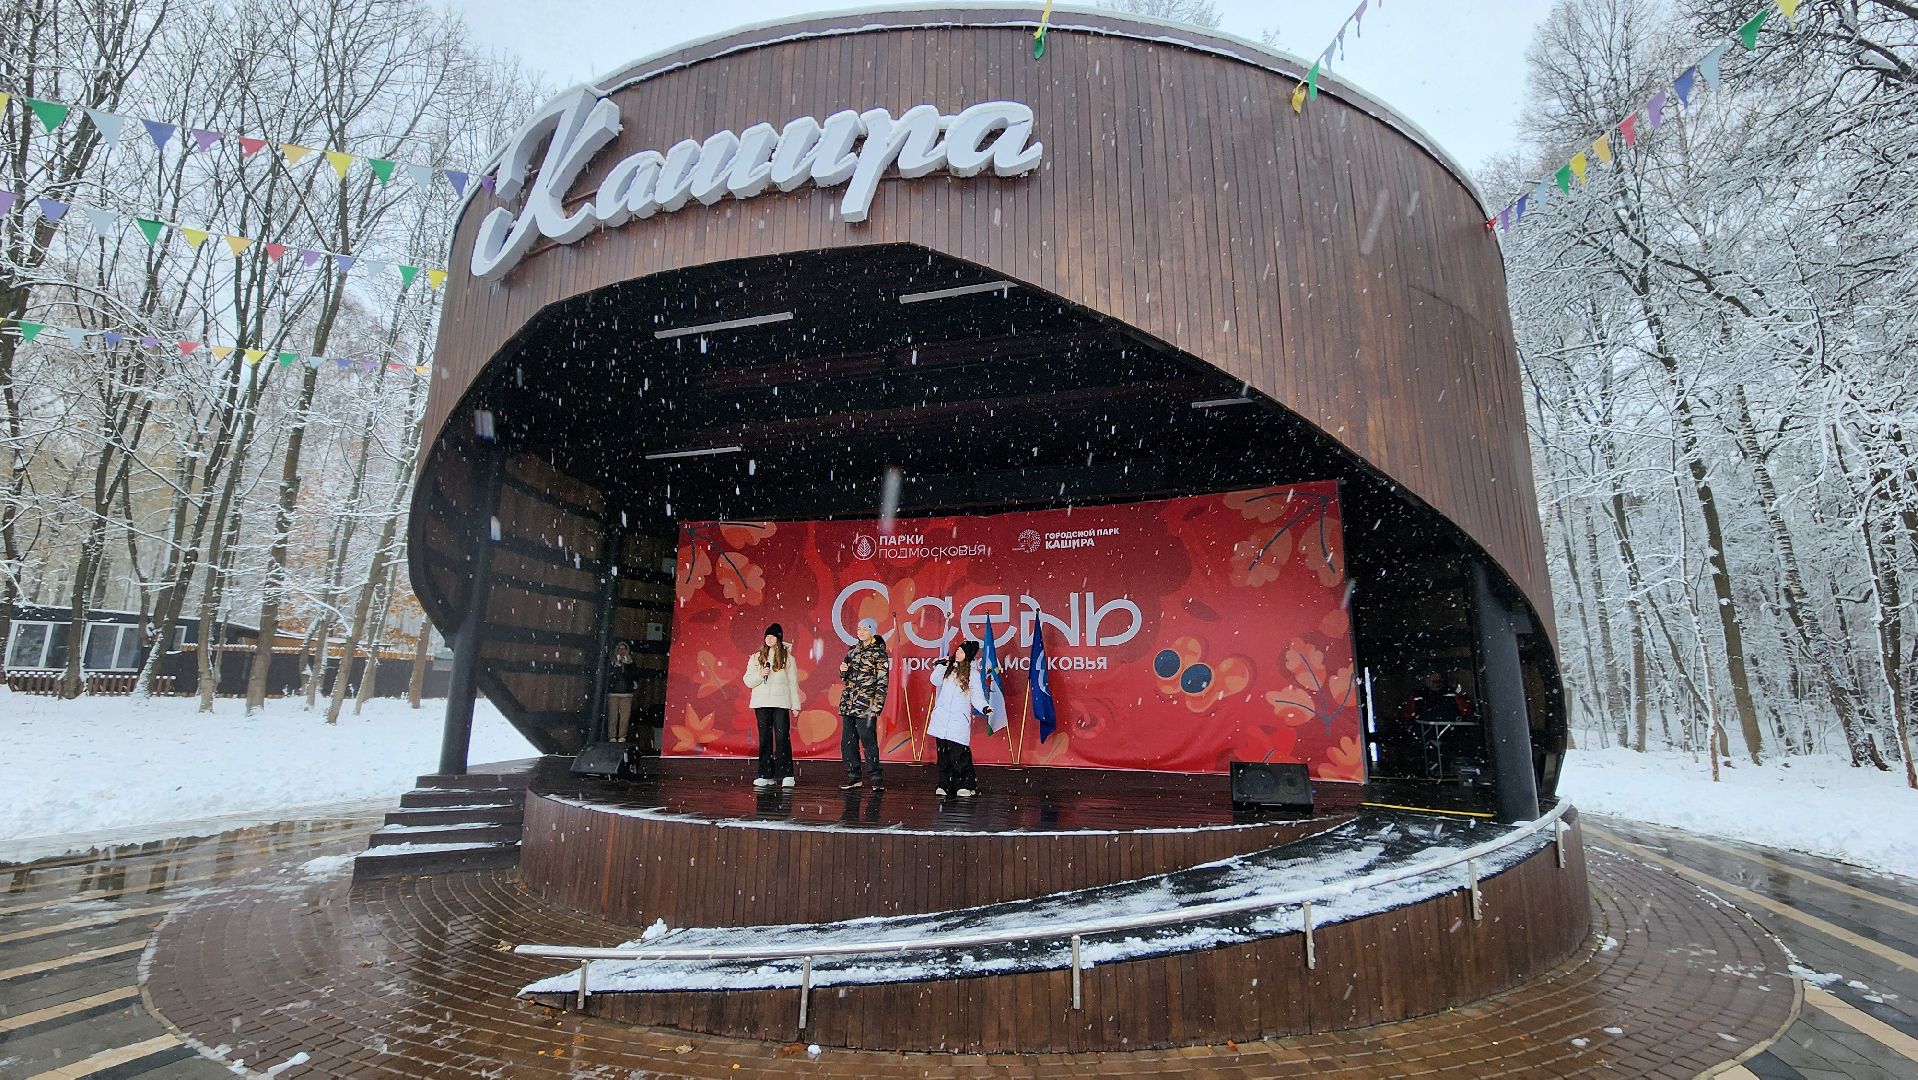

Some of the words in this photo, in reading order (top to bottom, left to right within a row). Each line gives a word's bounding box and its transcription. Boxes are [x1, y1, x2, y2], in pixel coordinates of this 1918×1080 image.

[470, 85, 1043, 281] Кашира
[879, 534, 925, 546] ПАРКИ
[1044, 528, 1096, 540] ГОРОДСКОЙ
[1096, 527, 1120, 536] ПАРК
[1045, 537, 1096, 550] КАШИРА
[878, 544, 987, 559] ПОДМОСКОВЬЯ
